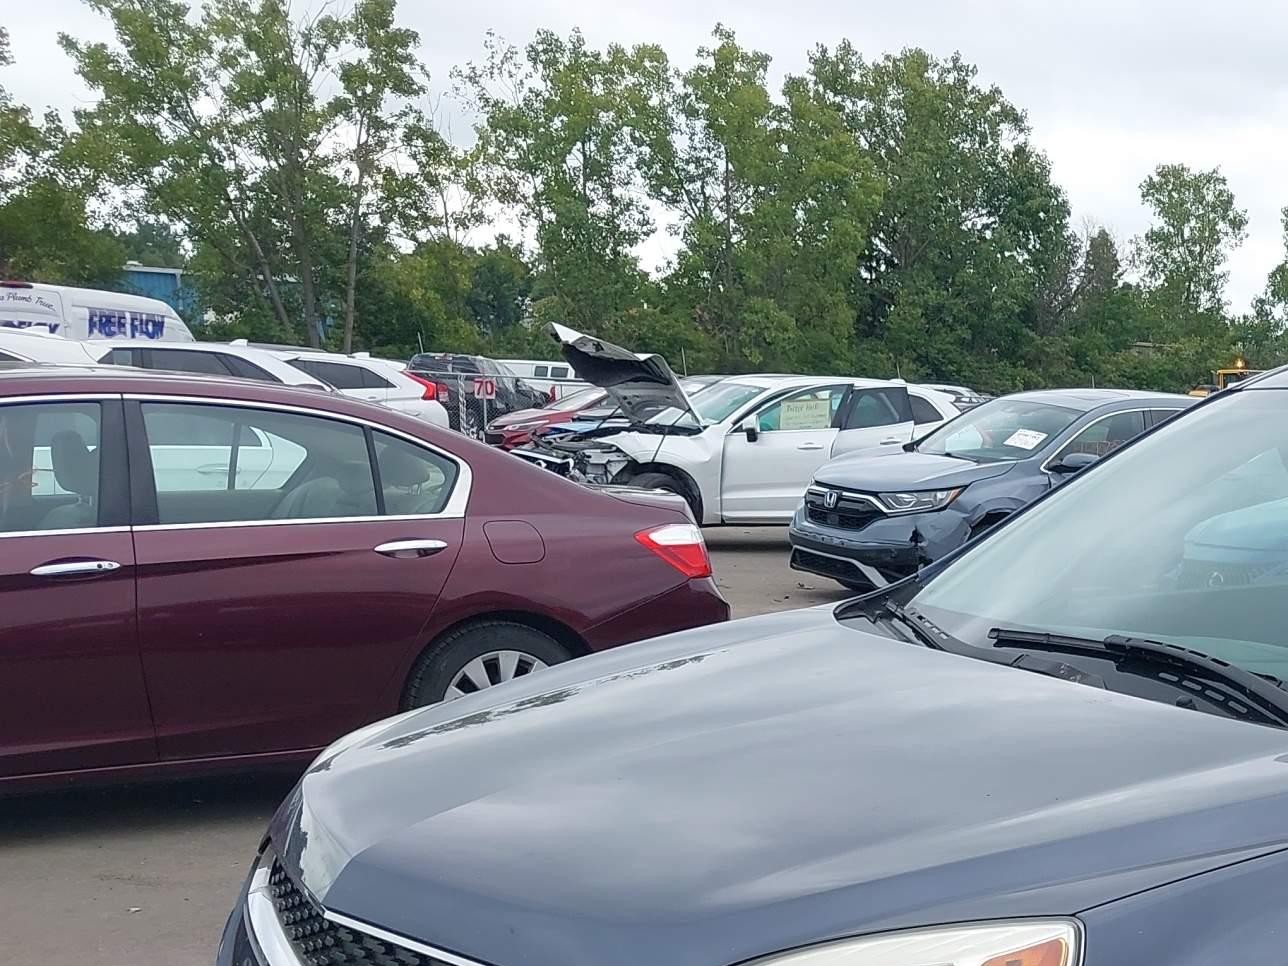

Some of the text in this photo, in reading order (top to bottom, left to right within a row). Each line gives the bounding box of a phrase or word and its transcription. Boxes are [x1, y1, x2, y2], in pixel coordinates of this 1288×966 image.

[88, 307, 127, 338] FREE
[129, 311, 166, 340] FLOW
[474, 380, 494, 396] 70
